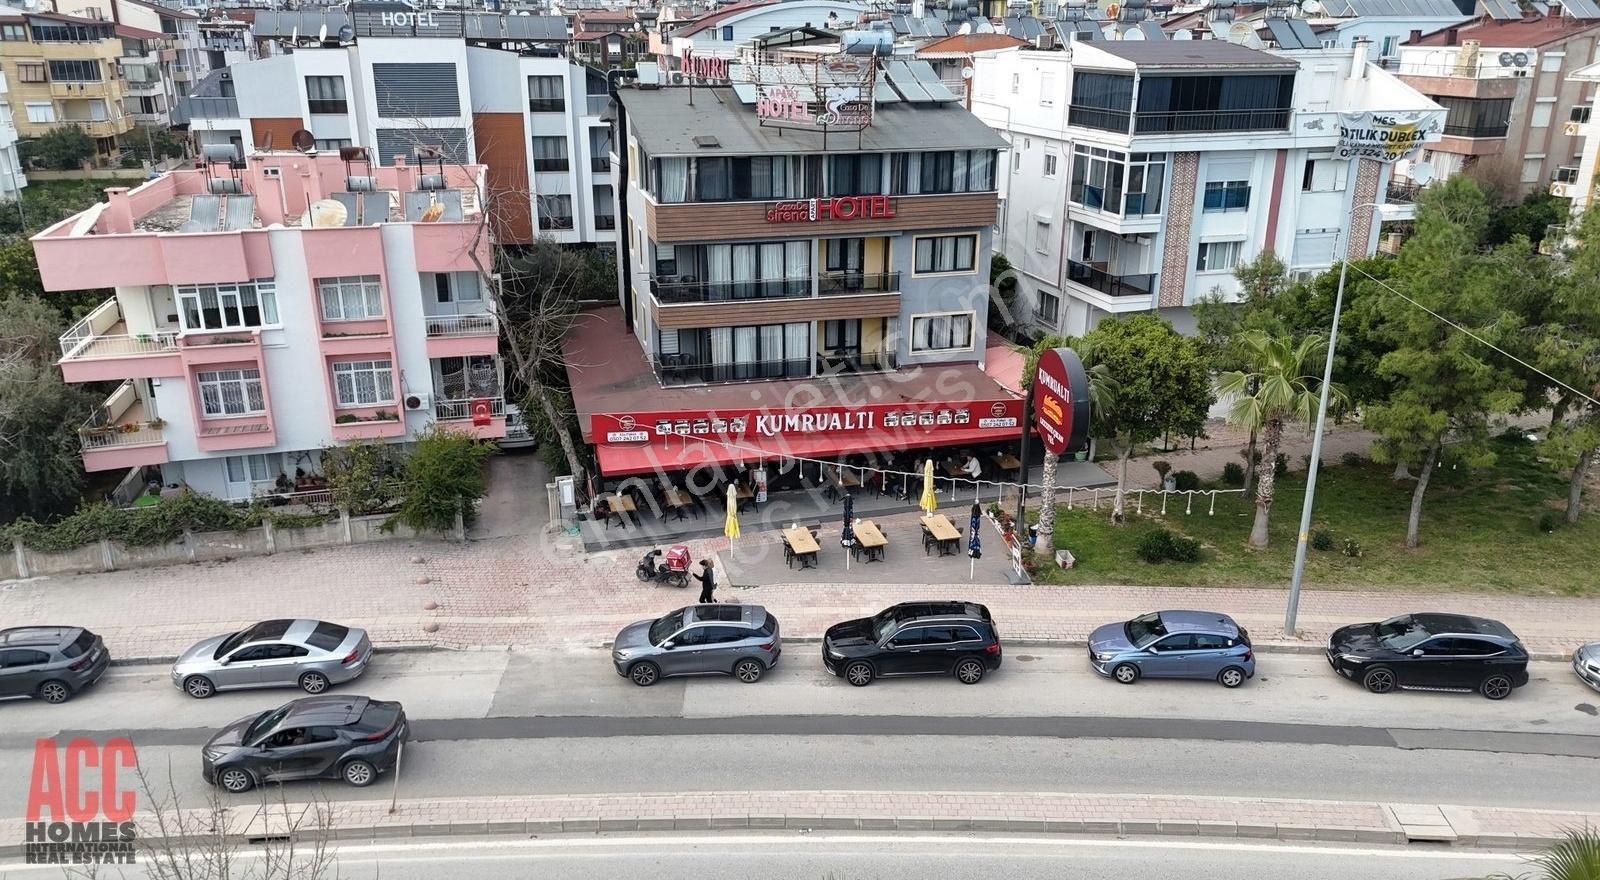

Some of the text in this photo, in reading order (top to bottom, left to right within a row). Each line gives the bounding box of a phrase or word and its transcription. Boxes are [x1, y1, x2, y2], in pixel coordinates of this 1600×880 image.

[381, 12, 439, 26] HOTEL
[757, 98, 813, 121] HOTEL
[1373, 115, 1396, 125] MES
[1379, 130, 1426, 142] DUBLEX
[1383, 152, 1397, 160] 20
[775, 201, 808, 210] Casa De
[816, 196, 897, 220] HOTEL
[767, 209, 808, 222] Sirena
[1038, 367, 1070, 404] KUMRUALTI
[755, 411, 874, 437] KUMRUALTI
